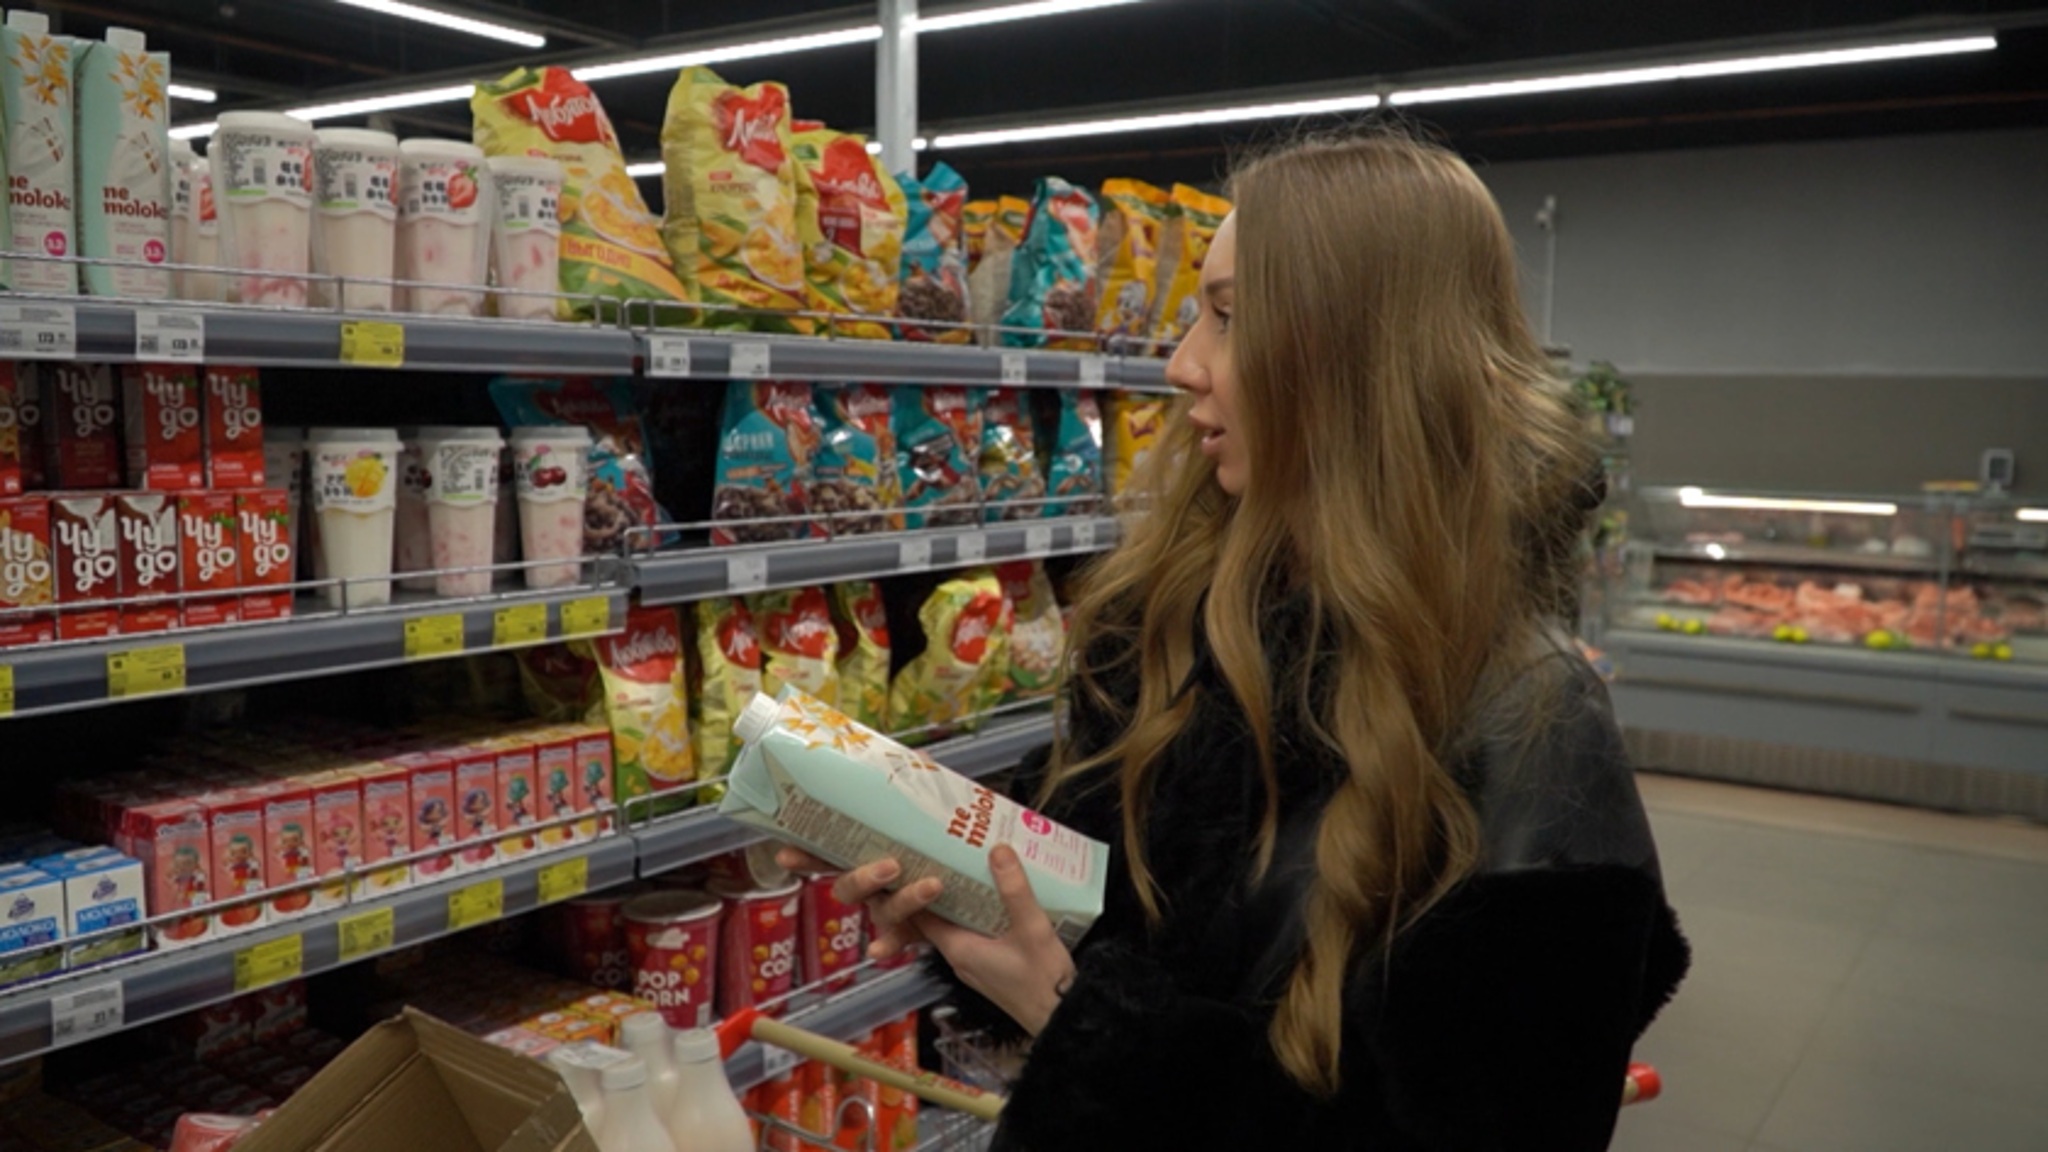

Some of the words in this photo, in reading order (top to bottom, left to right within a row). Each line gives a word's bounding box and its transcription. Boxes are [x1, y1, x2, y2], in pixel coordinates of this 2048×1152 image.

[103, 186, 129, 200] ne
[947, 806, 971, 838] ne
[638, 970, 681, 990] POP
